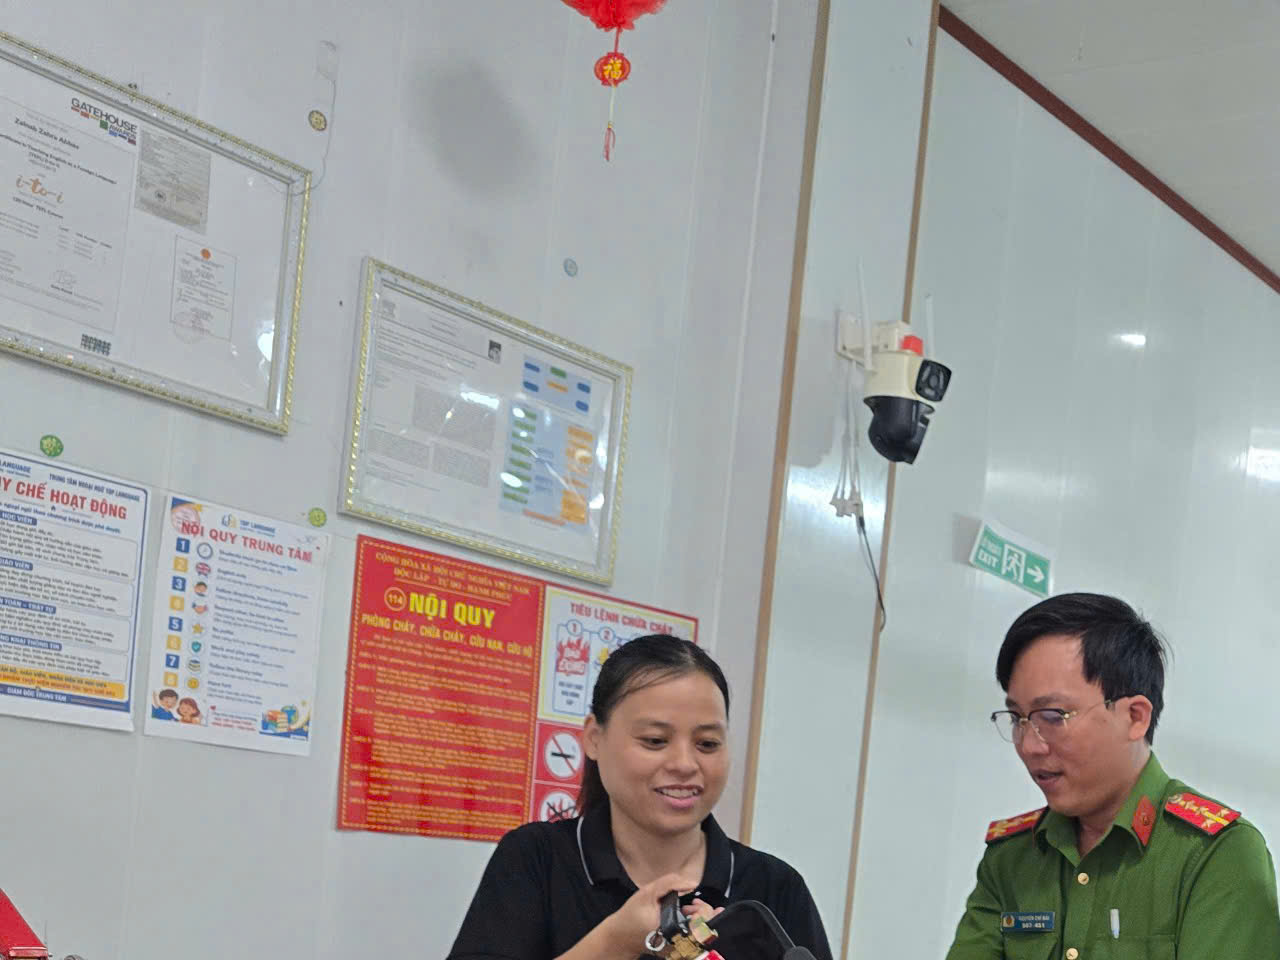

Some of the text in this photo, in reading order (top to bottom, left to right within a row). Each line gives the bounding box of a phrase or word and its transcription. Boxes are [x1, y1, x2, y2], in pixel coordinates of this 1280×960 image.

[71, 98, 137, 132] GATEHOUSE
[15, 481, 47, 500] CHẾ
[50, 489, 87, 511] HOẠT
[90, 497, 128, 520] ĐỘNG
[181, 520, 312, 563] NỘI QUY TRUNG TÂM
[387, 593, 403, 605] 114
[409, 592, 496, 629] NỘI QUY
[593, 606, 619, 623] LỆNH
[361, 613, 391, 628] PHÒNG
[419, 624, 441, 638] CHỮA
